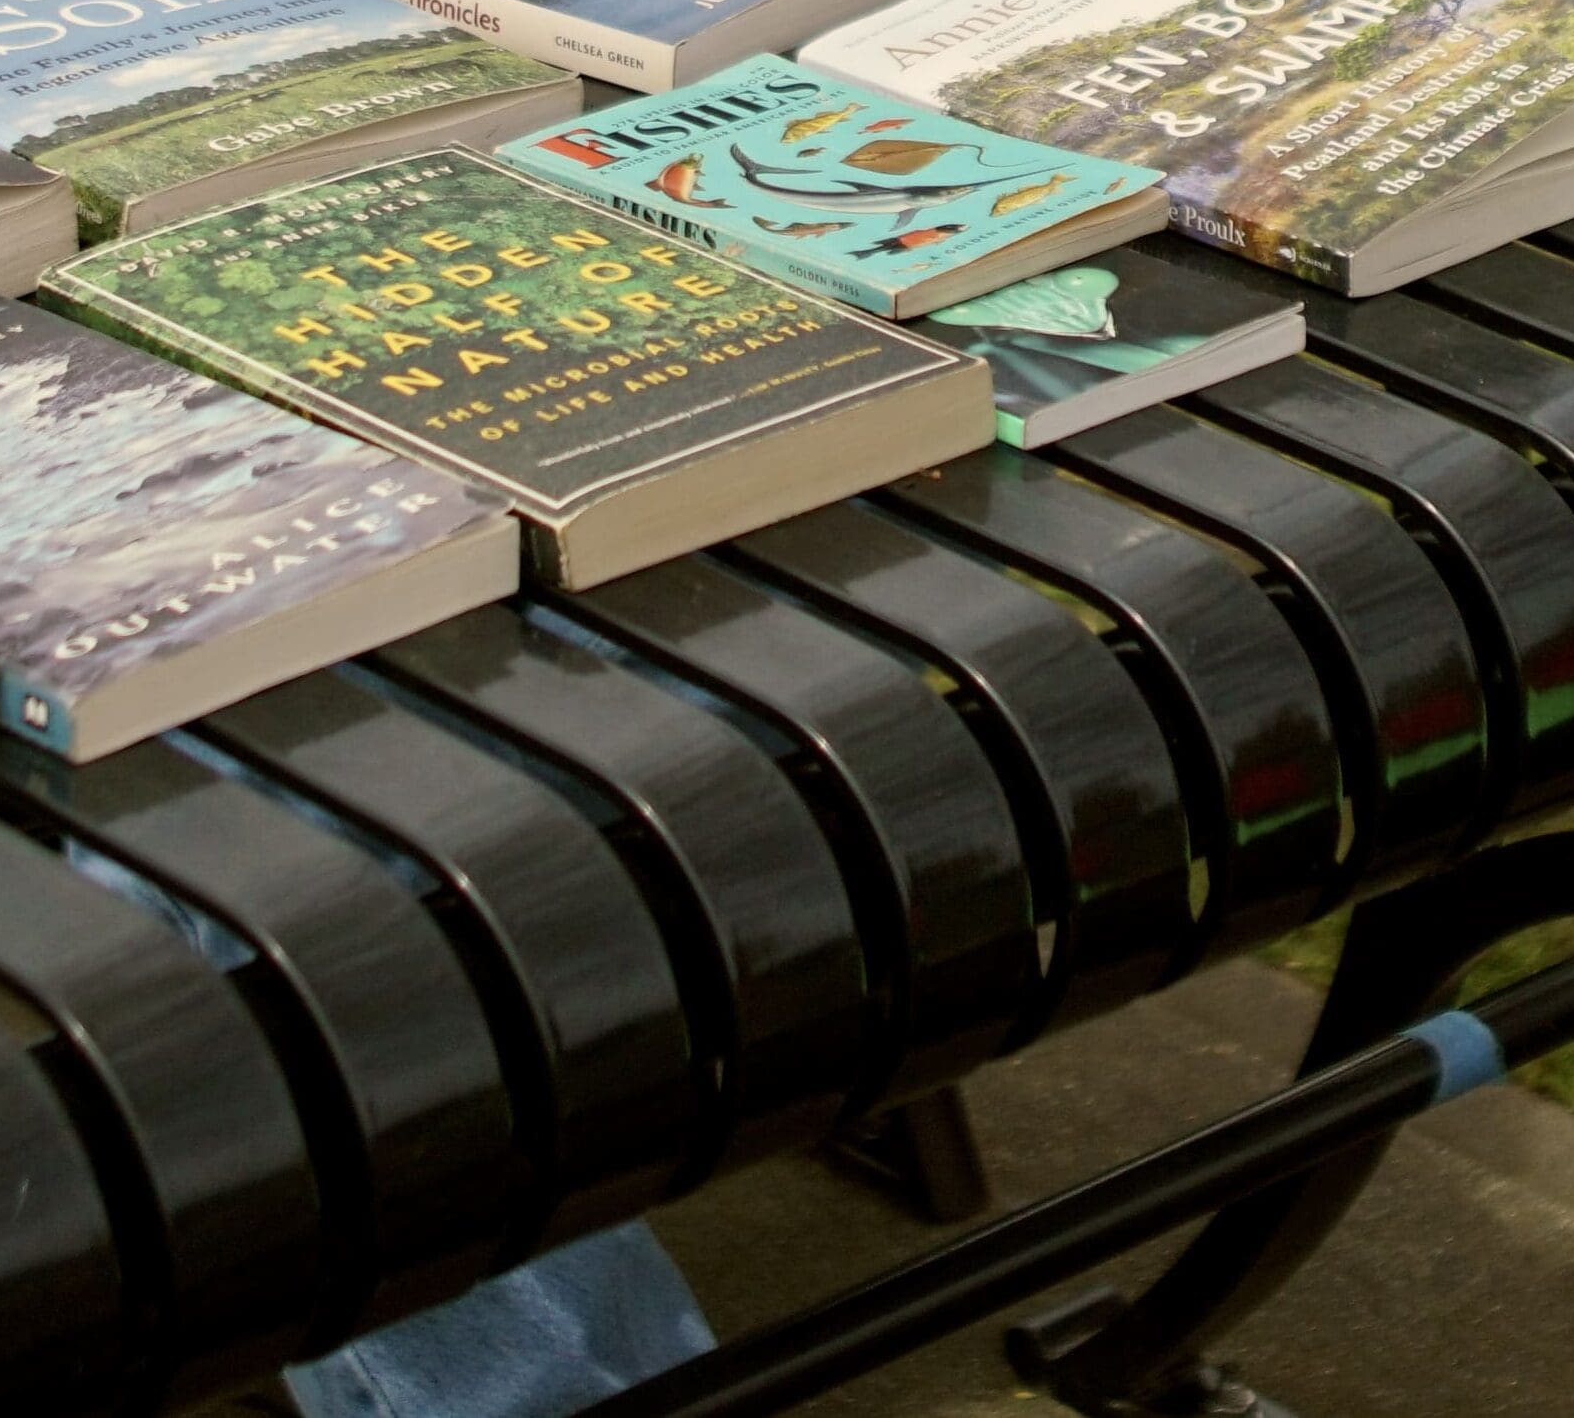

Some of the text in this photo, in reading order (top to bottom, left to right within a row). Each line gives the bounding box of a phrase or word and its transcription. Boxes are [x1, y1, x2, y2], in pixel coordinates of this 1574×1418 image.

[9, 5, 347, 97] Regenerative Agriculture
[32, 30, 157, 72] Family's
[162, 4, 272, 37] Journey
[554, 35, 645, 71] CHELSEA GREEN
[739, 68, 780, 89] COLOR
[1056, 45, 1210, 109] FEN,
[1265, 20, 1477, 160] A Short History of
[1279, 26, 1528, 183] Peatland Destruction
[207, 78, 460, 153] Gabe Brown
[528, 73, 821, 170] FISHES
[611, 156, 652, 174] GUIDE
[652, 148, 672, 161] TO
[675, 129, 732, 153] FAMILIAR
[732, 107, 799, 134] AMERICAN
[1150, 111, 1217, 139] &
[1360, 61, 1530, 173] and Its Role in
[1374, 163, 1426, 196] the
[1418, 105, 1516, 171] Climate
[261, 165, 455, 226] MONTGOMERY
[611, 195, 721, 250] FISHES
[944, 230, 1001, 255] GOLDEN
[1001, 205, 1057, 231] NATURE
[1057, 189, 1099, 208] GUIDE
[1184, 204, 1247, 248] Proulx
[264, 219, 342, 251] ANNE
[300, 228, 474, 288] THE
[273, 227, 612, 345] HIDDEN
[306, 244, 681, 380] HALF OF
[787, 264, 861, 299] GOLDEN PRESS
[379, 274, 728, 397] NATURE
[425, 400, 495, 431] THE
[503, 336, 686, 405] MICROBIAL
[693, 298, 800, 339] ROOTS
[478, 418, 522, 442] OF
[535, 389, 613, 424] LIFE
[624, 365, 689, 395] AND
[699, 319, 822, 365] HEALTH
[212, 476, 406, 571] ALICE
[53, 492, 440, 661] OUTWATER
